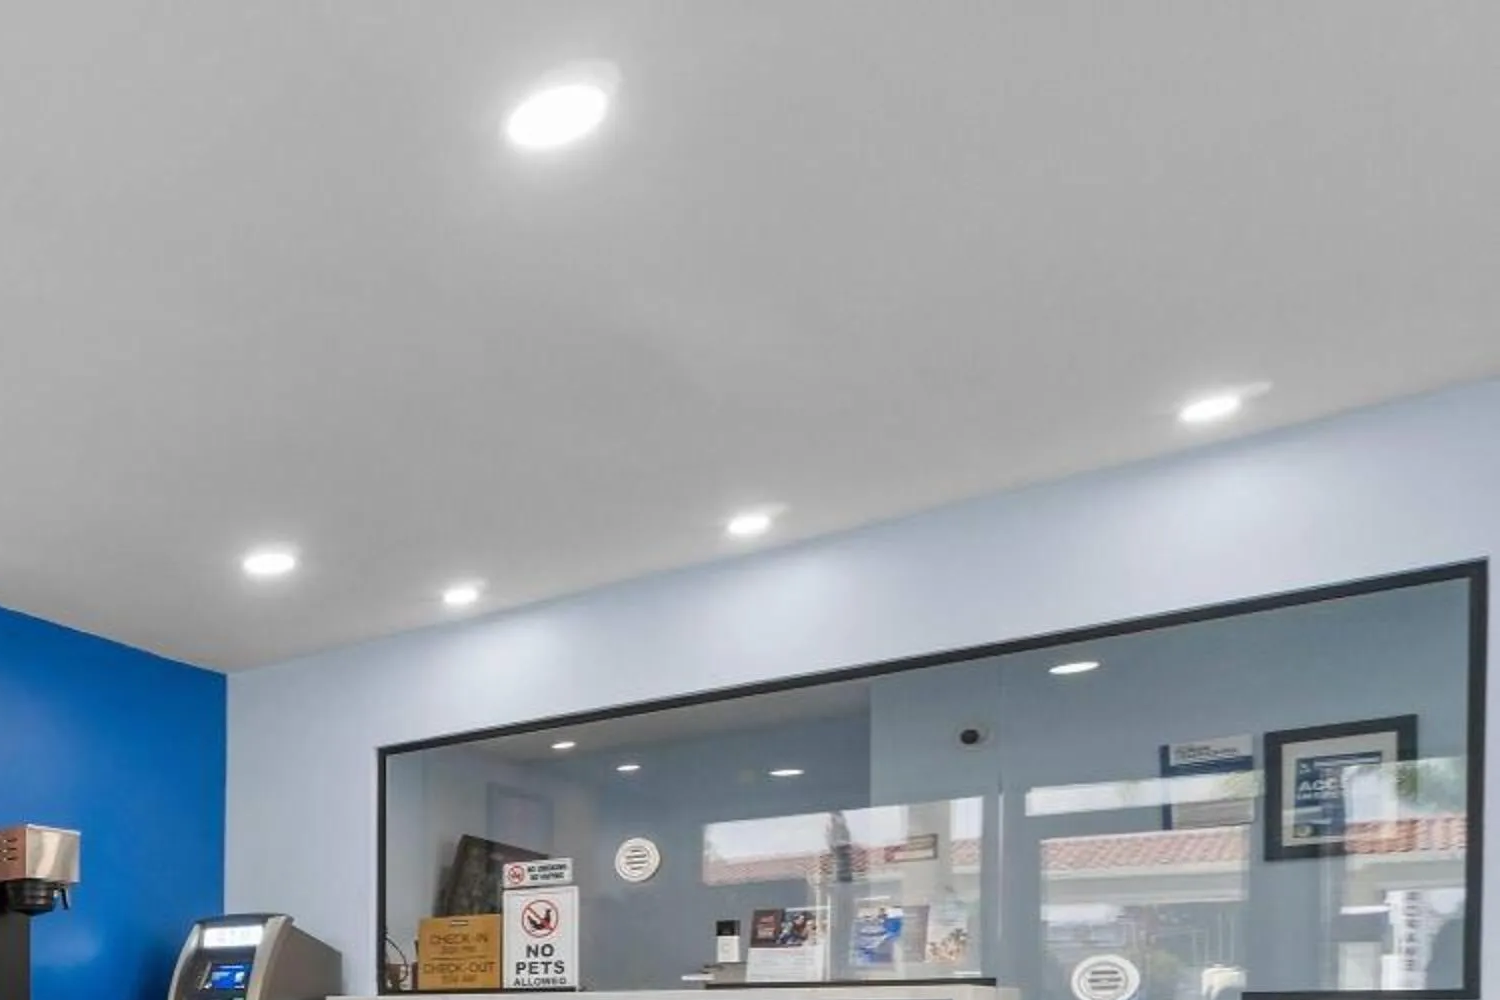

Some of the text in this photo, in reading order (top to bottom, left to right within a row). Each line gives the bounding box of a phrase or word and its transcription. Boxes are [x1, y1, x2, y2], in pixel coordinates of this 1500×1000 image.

[526, 944, 555, 958] NO
[423, 961, 496, 975] CHECK-OUT
[515, 960, 565, 975] PETS
[513, 977, 567, 987] ALLOWED
